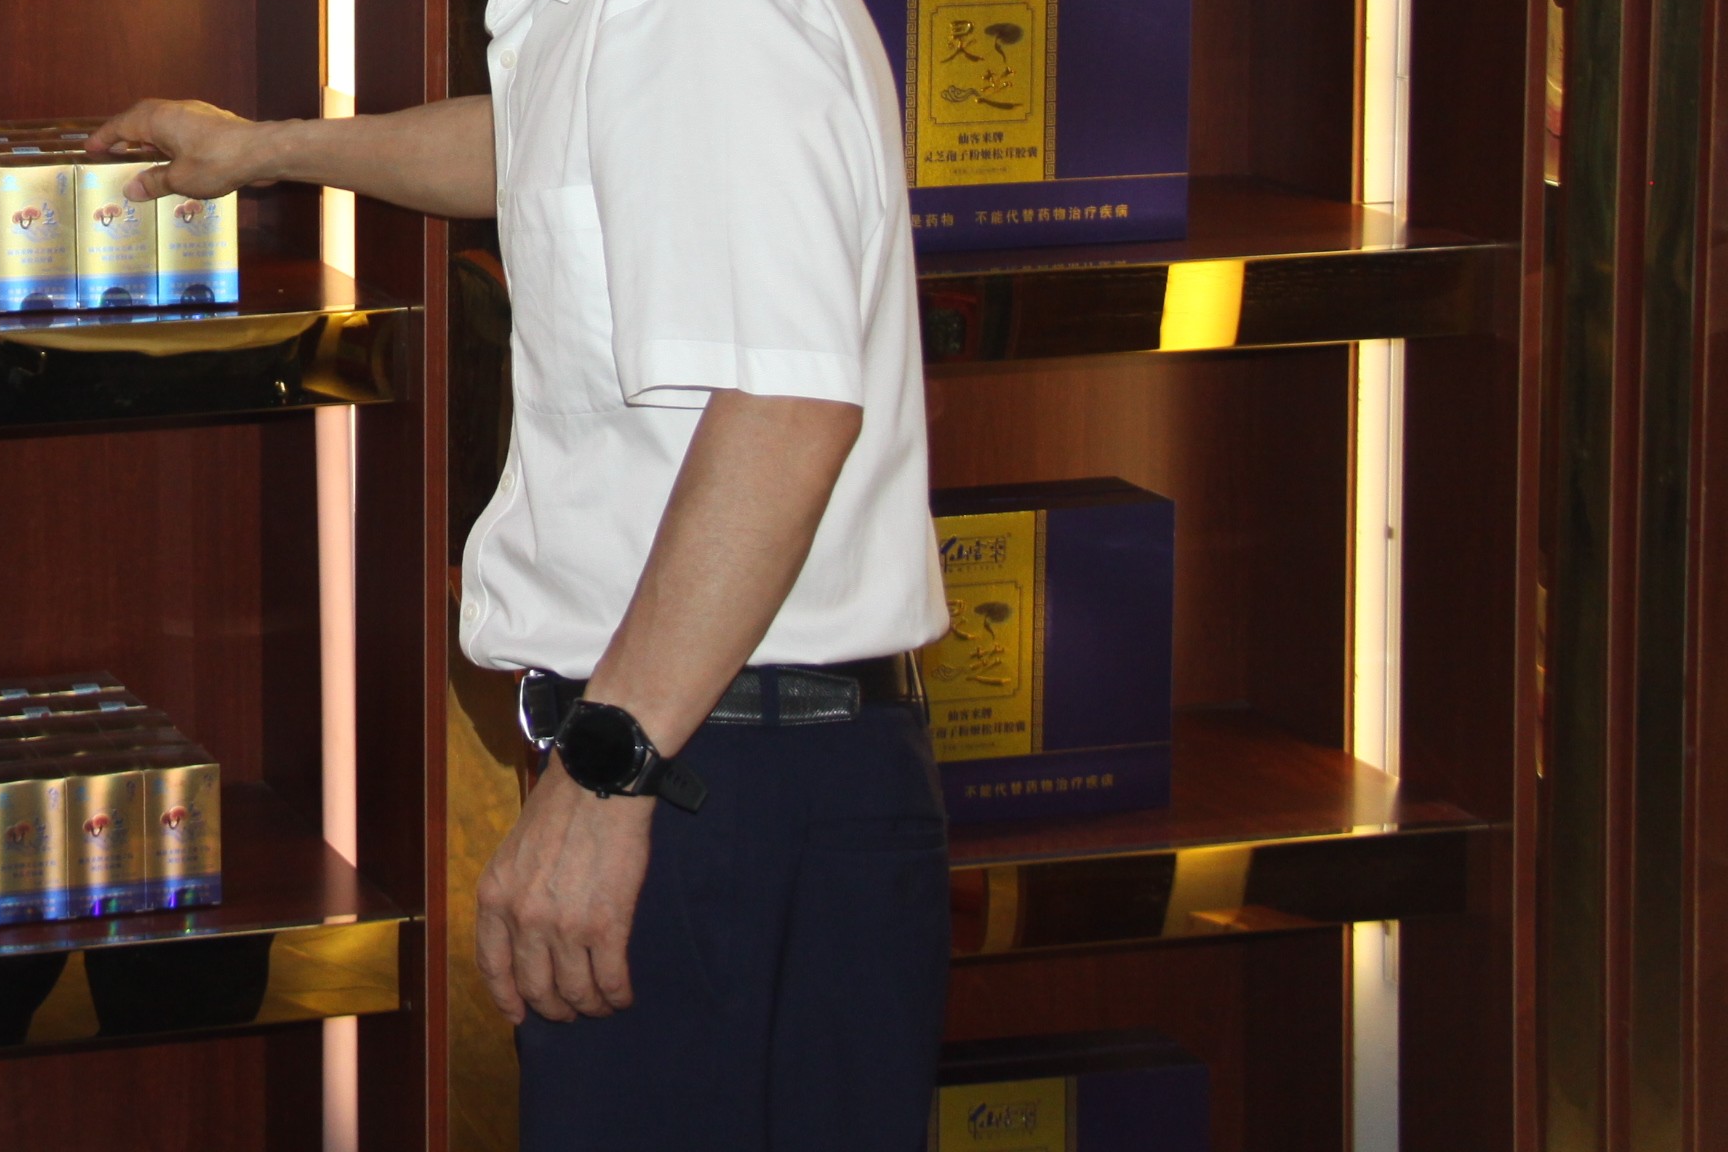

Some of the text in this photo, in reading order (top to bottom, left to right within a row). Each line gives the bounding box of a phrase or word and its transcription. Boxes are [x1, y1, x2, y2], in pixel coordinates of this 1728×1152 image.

[975, 204, 1129, 225] 不能代替药物治疗疾病
